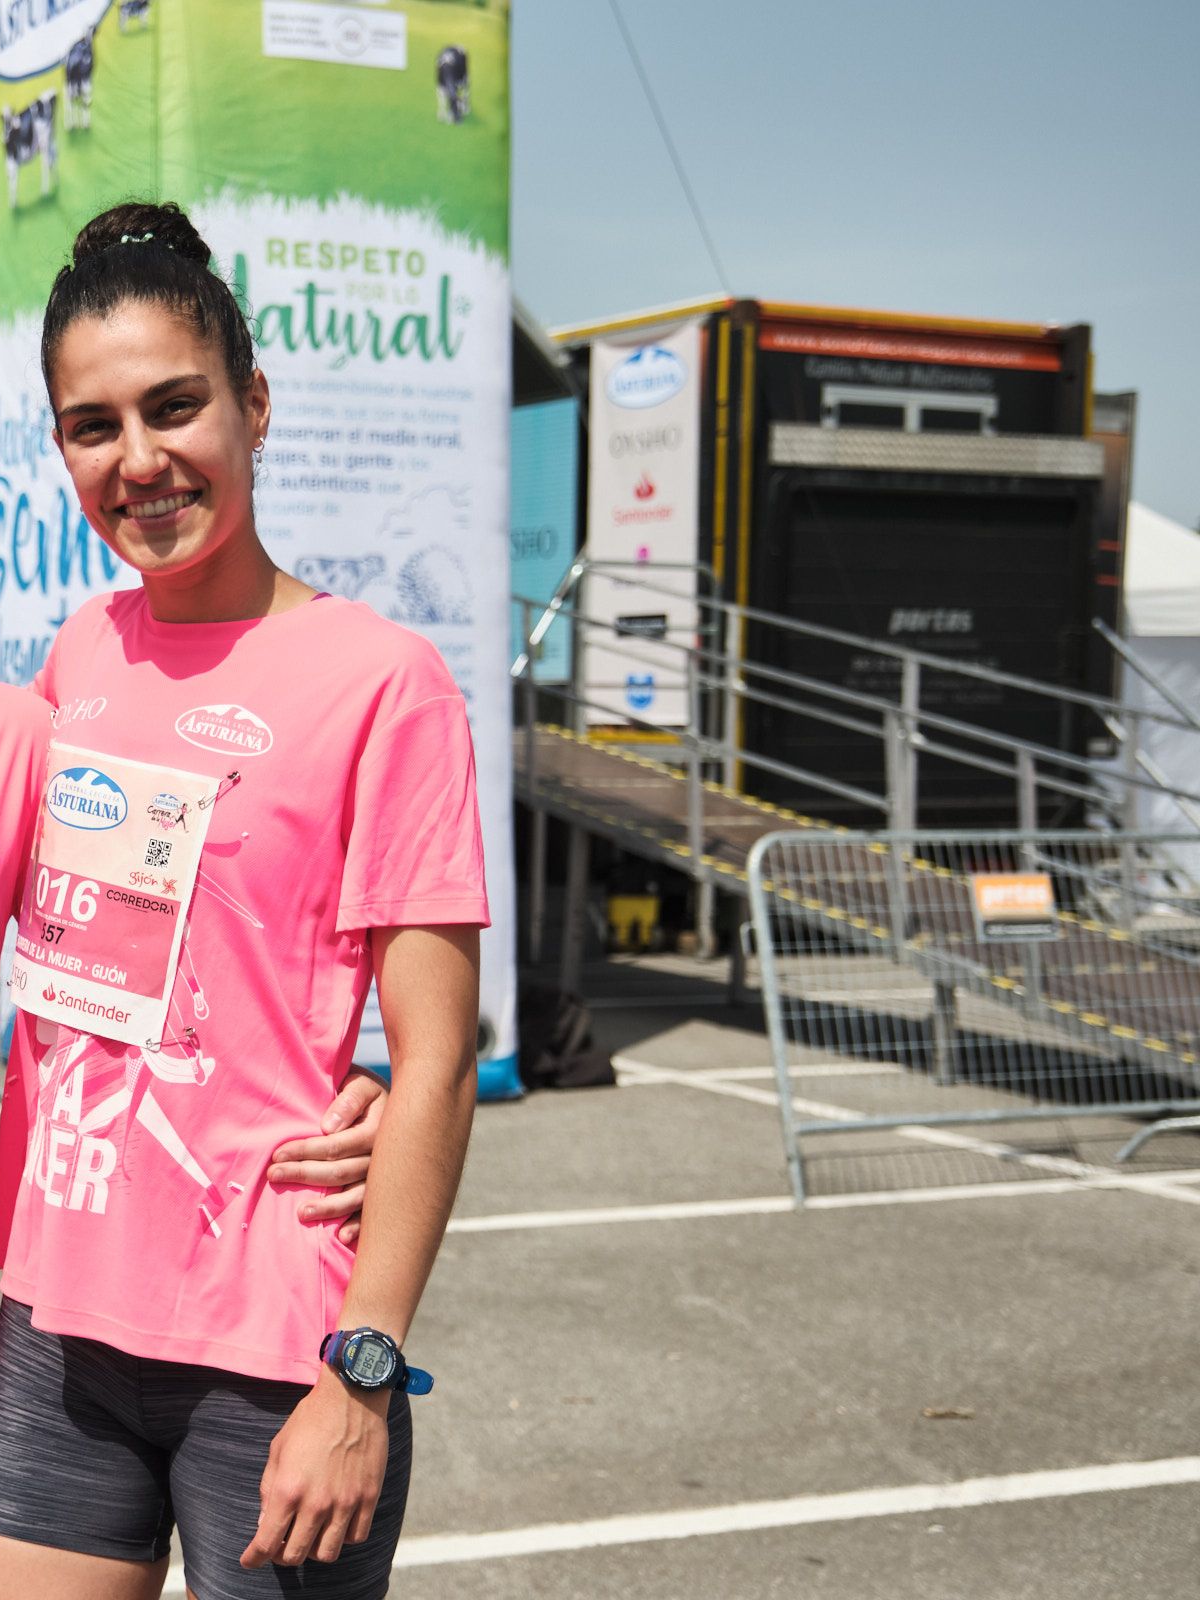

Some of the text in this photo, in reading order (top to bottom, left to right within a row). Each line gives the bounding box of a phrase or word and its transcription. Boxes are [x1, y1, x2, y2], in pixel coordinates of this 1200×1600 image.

[266, 238, 426, 278] RESPETO
[511, 525, 558, 561] SHO
[180, 714, 263, 752] ASTURIANA
[49, 783, 119, 821] ASTURIANA
[36, 867, 101, 922] 016
[106, 889, 175, 916] CORREDORA
[48, 950, 82, 973] MUJER
[91, 964, 127, 986] GIJÓN
[58, 991, 131, 1024] Santander
